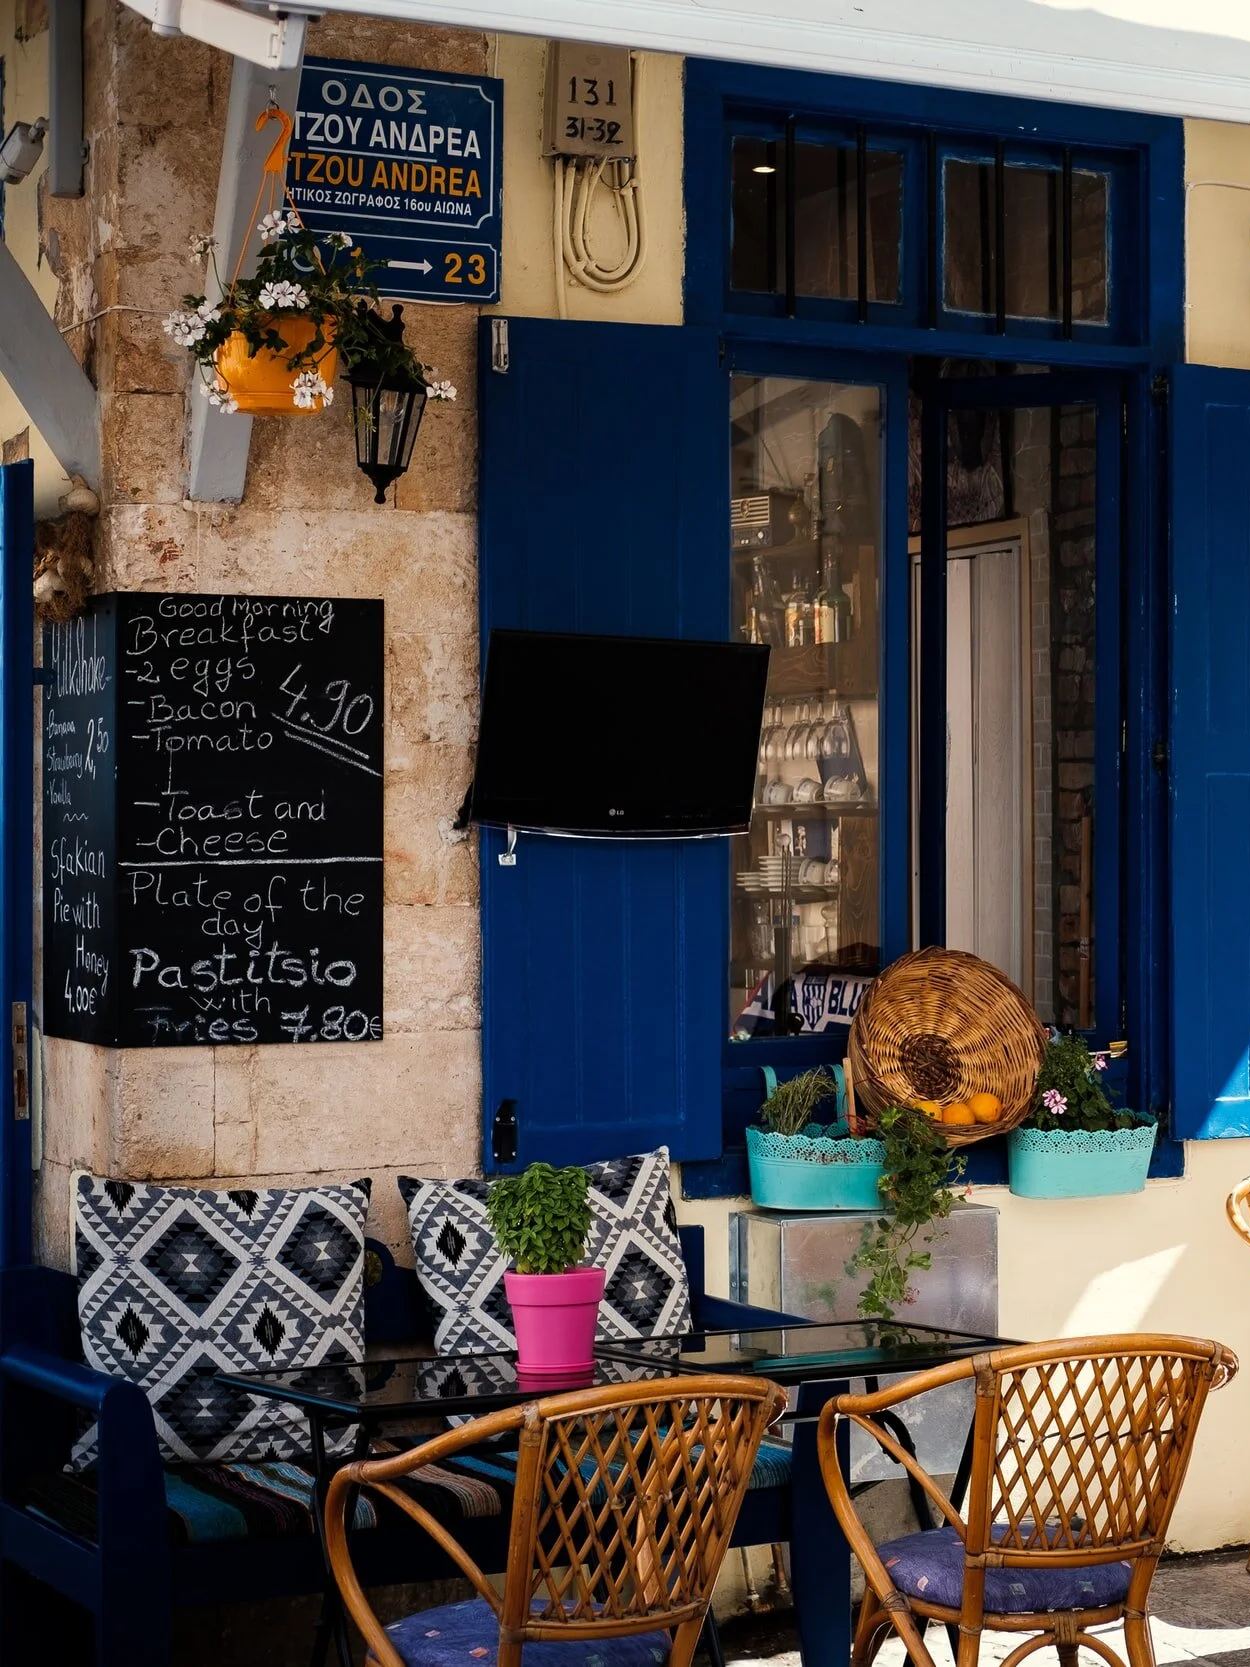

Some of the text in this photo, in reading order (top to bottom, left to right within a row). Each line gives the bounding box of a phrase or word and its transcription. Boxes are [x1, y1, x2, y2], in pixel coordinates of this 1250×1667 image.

[321, 79, 427, 115] ΟΔΟΣ
[568, 76, 616, 106] 131
[294, 111, 481, 159] ΤΖΟΥ ΑΝΔΡΕΑ
[565, 116, 624, 144] 31-32
[291, 151, 482, 198] TZOU ANDREA
[287, 187, 332, 203] ΗΤΙΚΟΣ
[335, 191, 401, 210] ΖΩΓΡΑΦΟΣ
[434, 199, 472, 217] ΑΙΩΝΑ
[444, 252, 486, 285] 23
[158, 596, 335, 634] Good Morning
[126, 613, 314, 656] Breakfast
[170, 656, 255, 698] eggs
[275, 790, 326, 821] and
[50, 835, 105, 885] Sfakian
[53, 887, 101, 929] Pie with
[126, 871, 365, 922] Plate of the
[201, 911, 264, 948] day
[75, 934, 109, 997] Honey
[128, 941, 357, 992] Pastitsio
[190, 987, 272, 1013] with
[827, 980, 870, 1018] BLU
